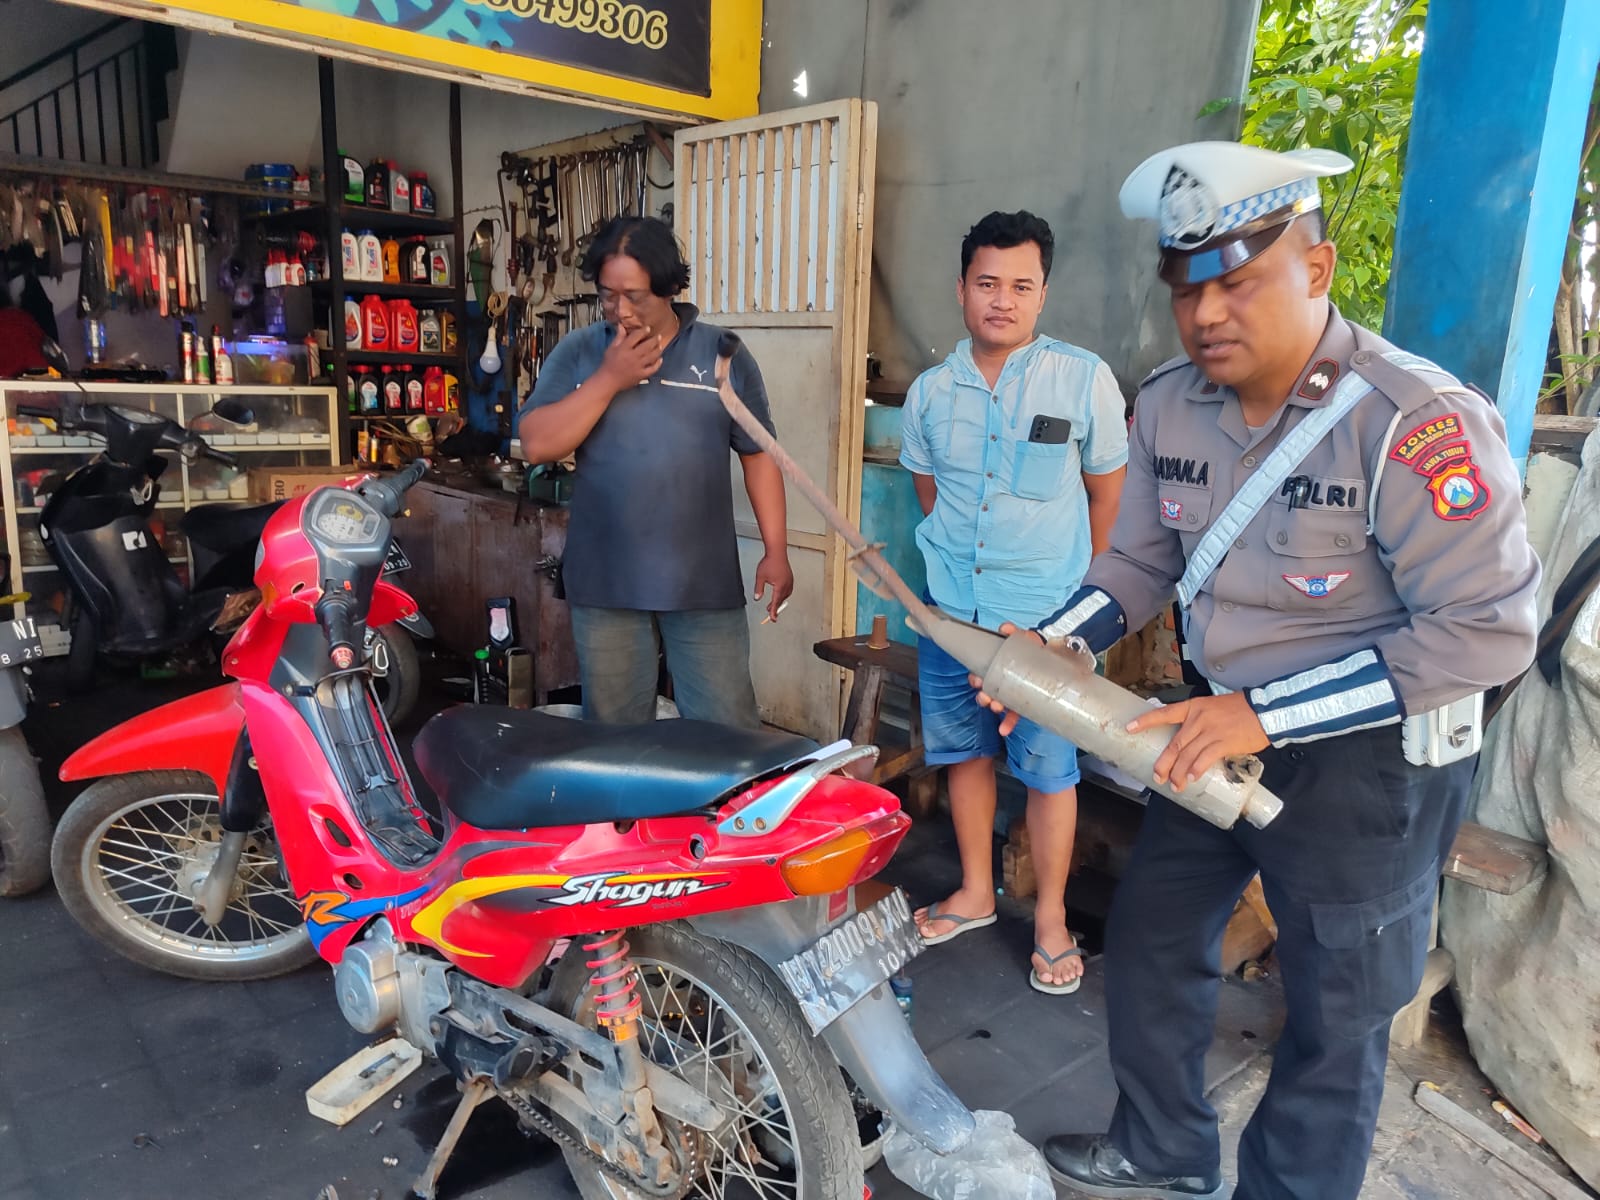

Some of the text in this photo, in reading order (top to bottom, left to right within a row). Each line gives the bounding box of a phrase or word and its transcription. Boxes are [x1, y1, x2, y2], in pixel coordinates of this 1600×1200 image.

[1398, 418, 1455, 456] POLRES
[23, 645, 43, 659] 25
[540, 871, 732, 909] Shogun
